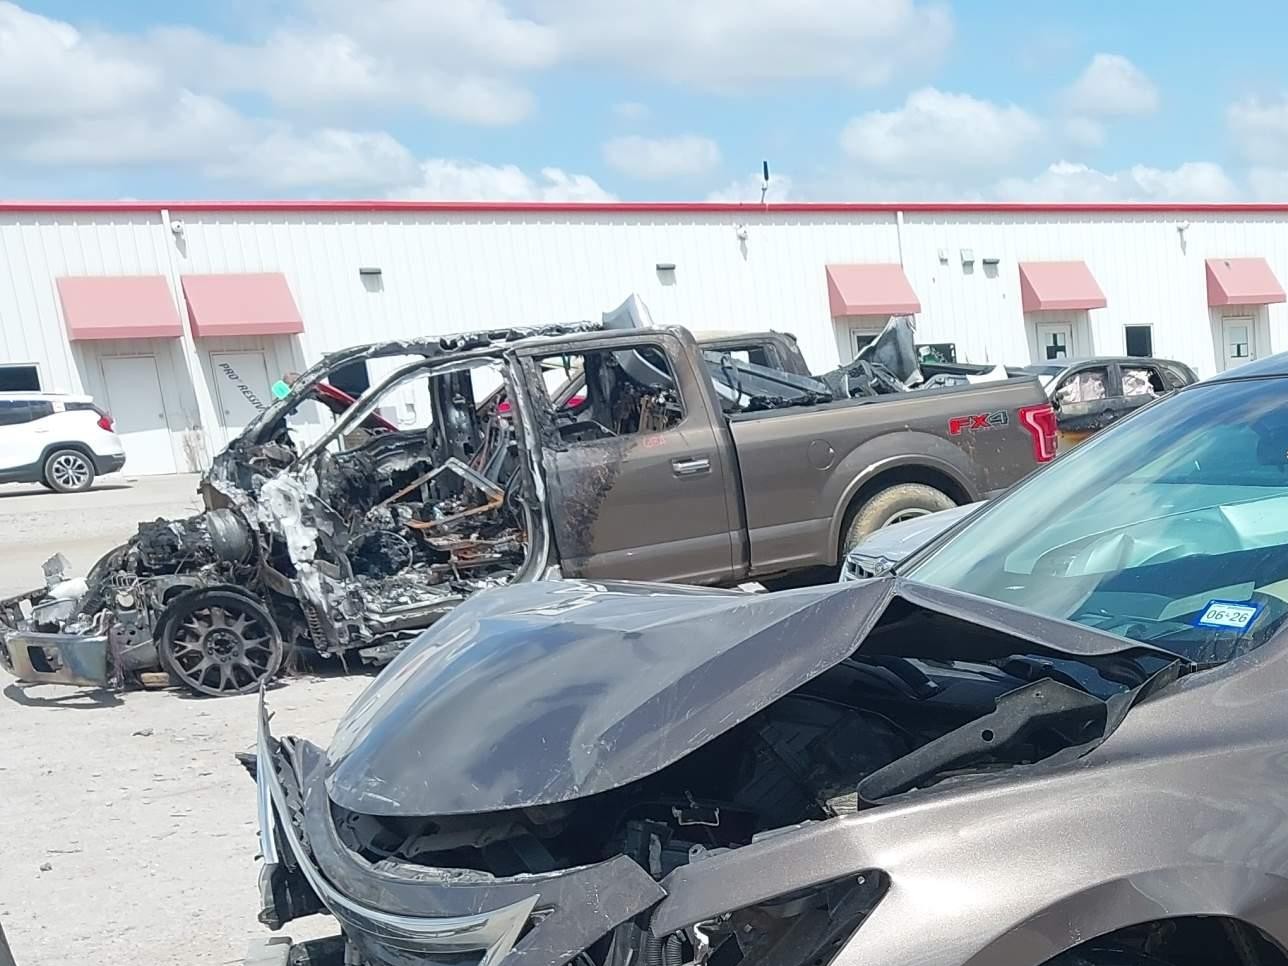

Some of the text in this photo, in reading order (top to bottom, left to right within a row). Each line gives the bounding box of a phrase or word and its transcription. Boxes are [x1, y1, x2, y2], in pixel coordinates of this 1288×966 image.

[948, 410, 1009, 436] FX4
[1206, 609, 1250, 623] 06 26
